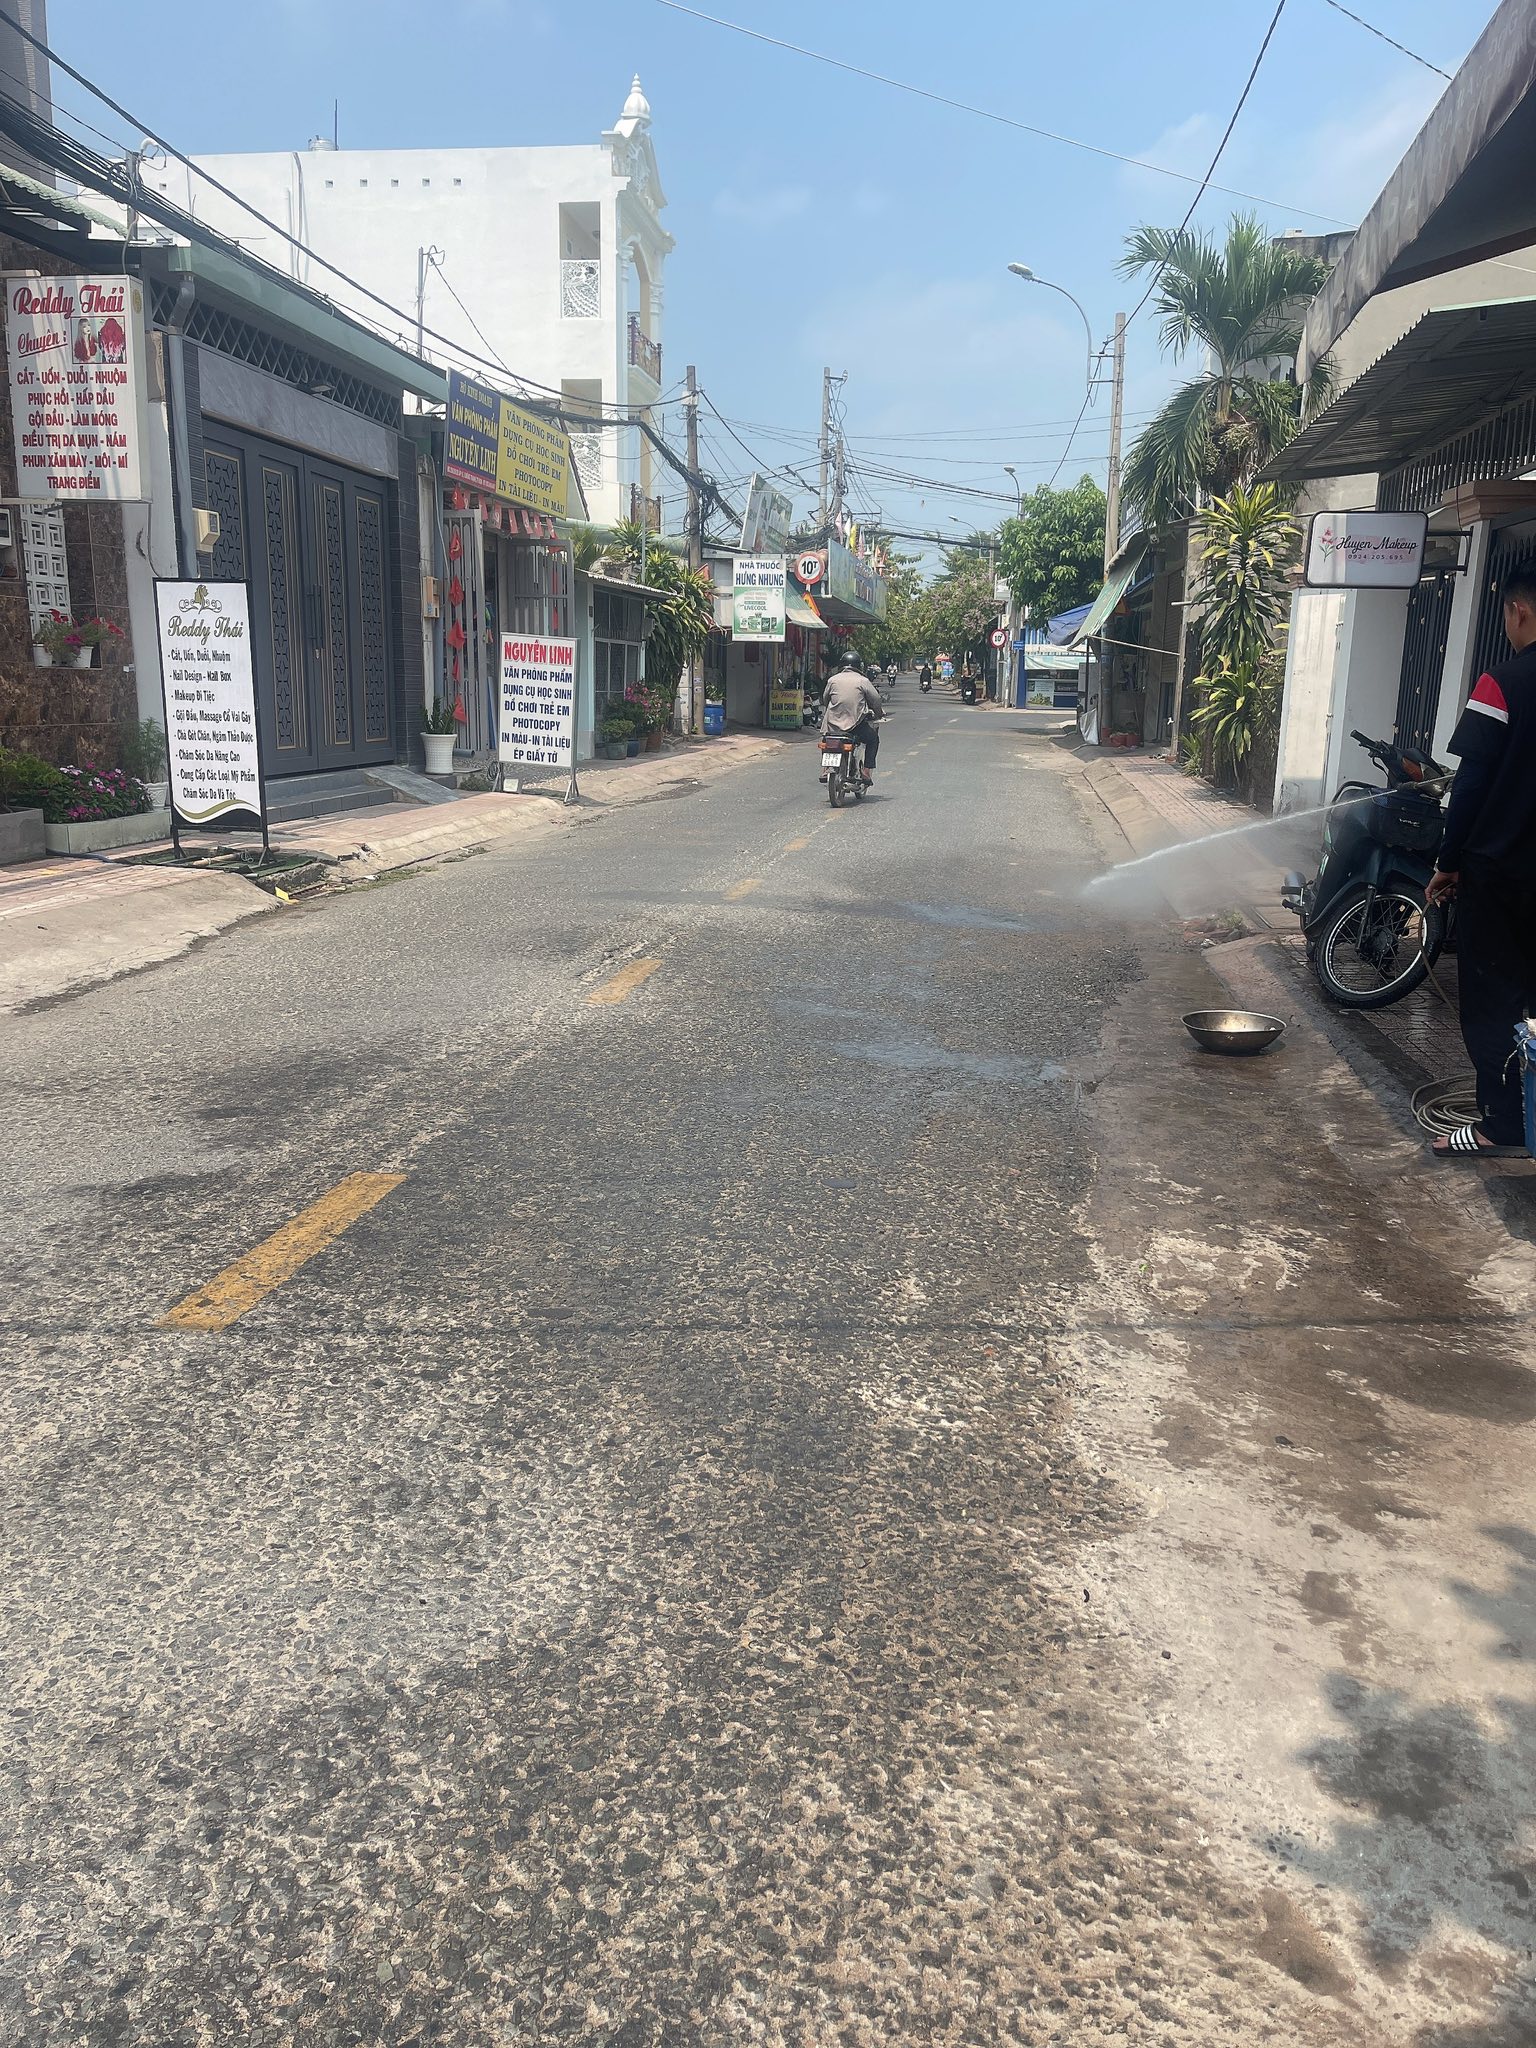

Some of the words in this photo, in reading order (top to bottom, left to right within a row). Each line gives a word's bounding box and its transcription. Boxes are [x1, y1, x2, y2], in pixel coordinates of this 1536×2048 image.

[13, 286, 75, 319] Reddy
[80, 285, 124, 313] Thái
[17, 367, 34, 384] CẮT
[42, 367, 60, 384] UỐN
[67, 366, 88, 384] DUỖI
[96, 368, 127, 386] NHUỘM
[28, 393, 51, 407] PHỤC
[54, 387, 69, 405] HỒI
[76, 387, 94, 405] HẤP
[97, 387, 114, 405] DẦU
[29, 410, 44, 428] GỘI
[46, 408, 64, 426] ĐẦU
[71, 410, 89, 426] LÀM
[92, 410, 117, 426] MÓNG
[452, 400, 463, 424] VĂN
[464, 405, 483, 432] PHÒNG
[483, 413, 498, 440] PHẨM
[507, 410, 521, 426] VĂN
[523, 419, 544, 439] PHÒNG
[547, 433, 564, 449] PHẨM
[23, 430, 43, 447] ĐIỀU
[46, 435, 60, 449] TRỊ
[63, 435, 75, 447] DA
[78, 435, 98, 449] MỤN
[106, 431, 127, 447] NÁM
[503, 427, 523, 445] DỤNG
[525, 439, 534, 451] CỤ
[536, 445, 549, 461] HỌC
[551, 452, 565, 467] SINH
[23, 455, 46, 467] PHUN
[48, 452, 66, 467] XĂM
[69, 452, 87, 467] MÀY
[95, 452, 111, 468] MÔI
[118, 453, 128, 468] MÍ
[480, 446, 496, 475] LINH
[507, 444, 516, 460] ĐỒ
[519, 453, 535, 469] CHƠI
[538, 461, 549, 475] TRẺ
[552, 469, 561, 481] EM
[47, 477, 77, 489] TRANG
[79, 471, 100, 489] ĐIỂM
[515, 468, 553, 493] PHOTOCOPY
[499, 480, 506, 491] IN
[509, 483, 521, 498] TÀI
[523, 486, 538, 504] LIỆU
[543, 497, 549, 508] IN
[551, 500, 565, 514] MÀU
[1336, 536, 1372, 554] Huyen
[1373, 537, 1418, 554] Makeup
[740, 561, 756, 570] NHÀ
[756, 561, 780, 570] THUỐC
[759, 573, 784, 586] NHUNG
[168, 616, 211, 645] Reddy
[214, 617, 243, 637] Thái
[212, 650, 231, 664] Nhuộm
[504, 640, 547, 663] NGUYÊN
[549, 646, 573, 666] LINH
[173, 670, 183, 681] Nail
[184, 670, 202, 683] Design
[504, 666, 519, 679] VĂN
[522, 668, 547, 681] PHÒNG
[550, 668, 572, 683] PHẨM
[174, 690, 195, 702] Makeup
[196, 690, 202, 701] Đi
[203, 690, 215, 704] Tiệc
[503, 684, 523, 697] DỤNG
[526, 686, 535, 698] CỤ
[537, 687, 552, 700] HỌC
[554, 689, 572, 700] SINH
[505, 698, 515, 711] ĐỒ
[518, 701, 537, 713] CHƠI
[540, 701, 554, 714] TRẺ
[557, 706, 569, 716] EM
[200, 710, 222, 723] Massage
[231, 710, 240, 722] Vai
[513, 717, 560, 731] PHOTOCOPY
[502, 732, 509, 742] IN
[542, 734, 553, 747] TÀI
[555, 736, 570, 750] LIỆU
[179, 749, 194, 760] Chăm
[195, 749, 205, 761] Sóc
[206, 750, 214, 761] Da
[230, 751, 240, 762] Cao
[514, 747, 523, 759] ÉP
[527, 748, 545, 762] GIẤY
[548, 751, 558, 763] TỜ
[180, 768, 194, 781] Cung
[195, 768, 205, 782] Cấp
[206, 768, 217, 781] Các
[218, 770, 229, 783] Loại
[210, 788, 217, 799] Da
